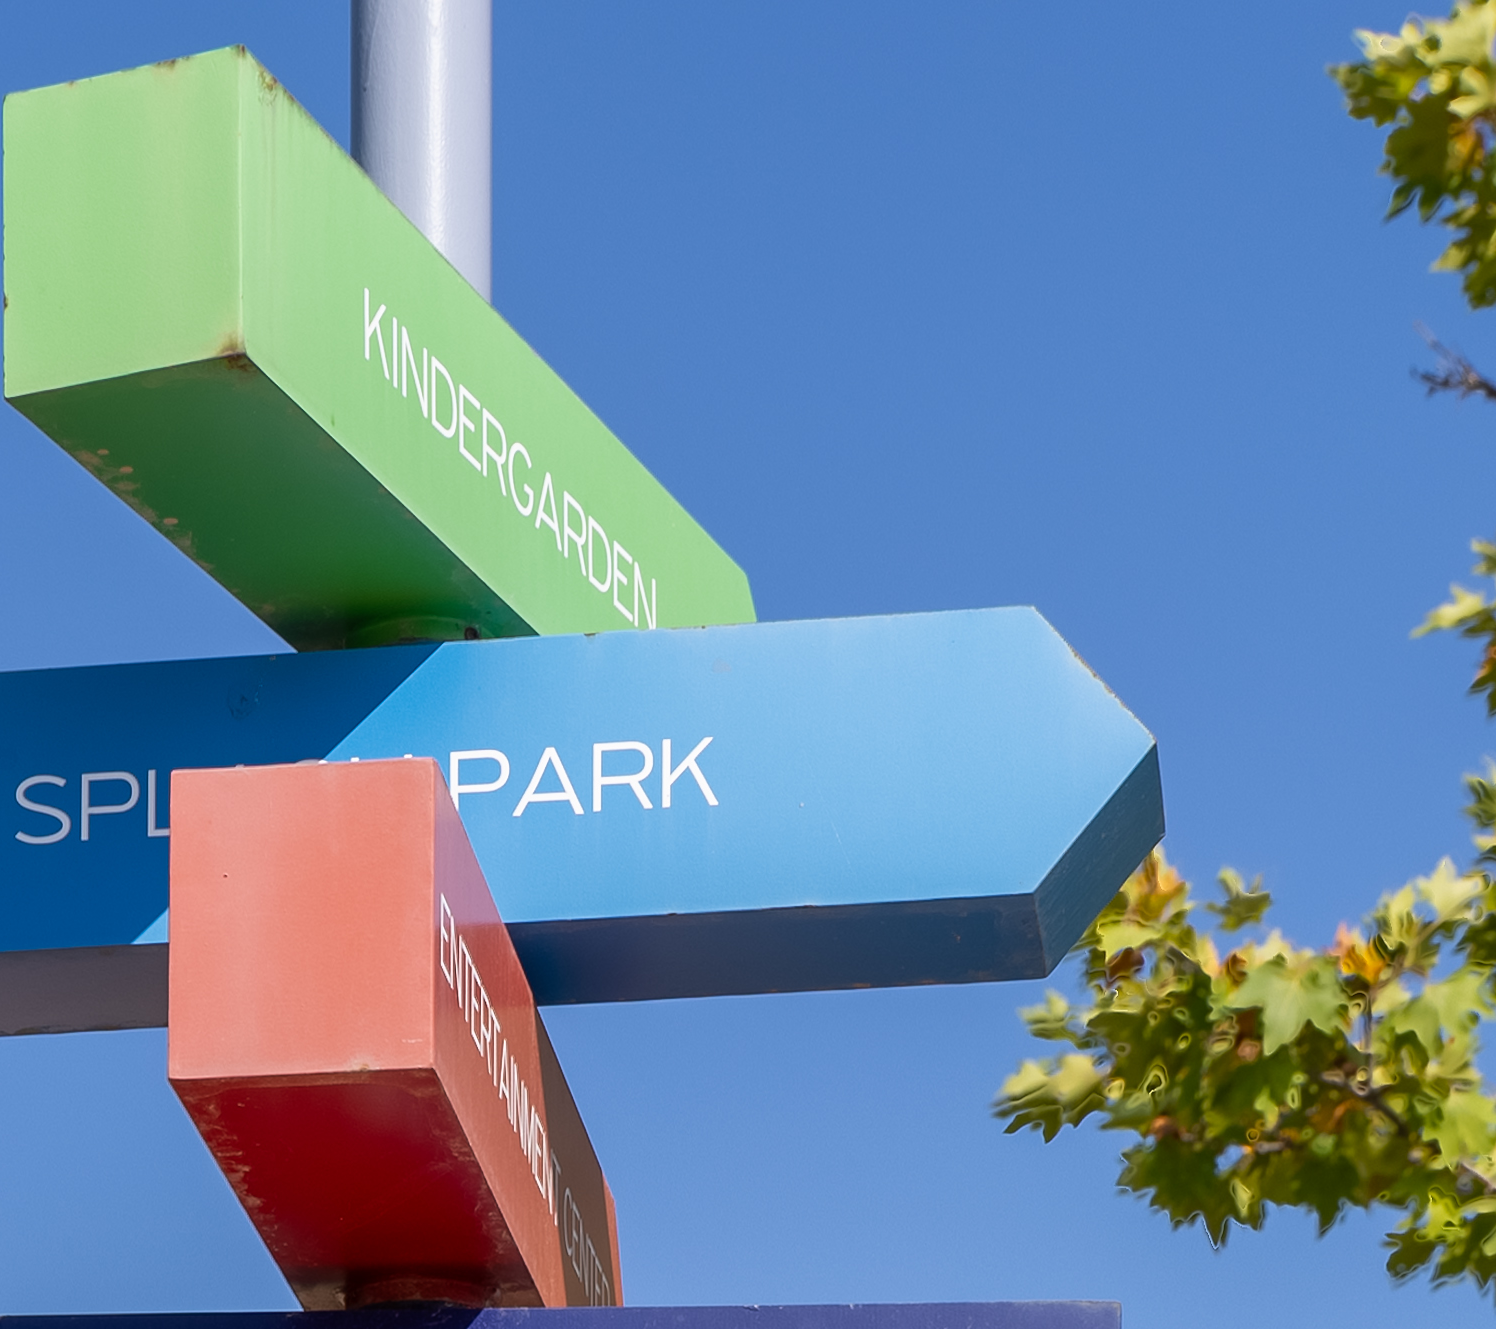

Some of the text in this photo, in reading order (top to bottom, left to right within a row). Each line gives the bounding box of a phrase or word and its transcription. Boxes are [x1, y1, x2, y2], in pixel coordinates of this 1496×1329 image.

[364, 287, 656, 630] KINDERGARDEN
[449, 736, 719, 818] PARK
[440, 893, 562, 1227] ENTERTAINMENT
